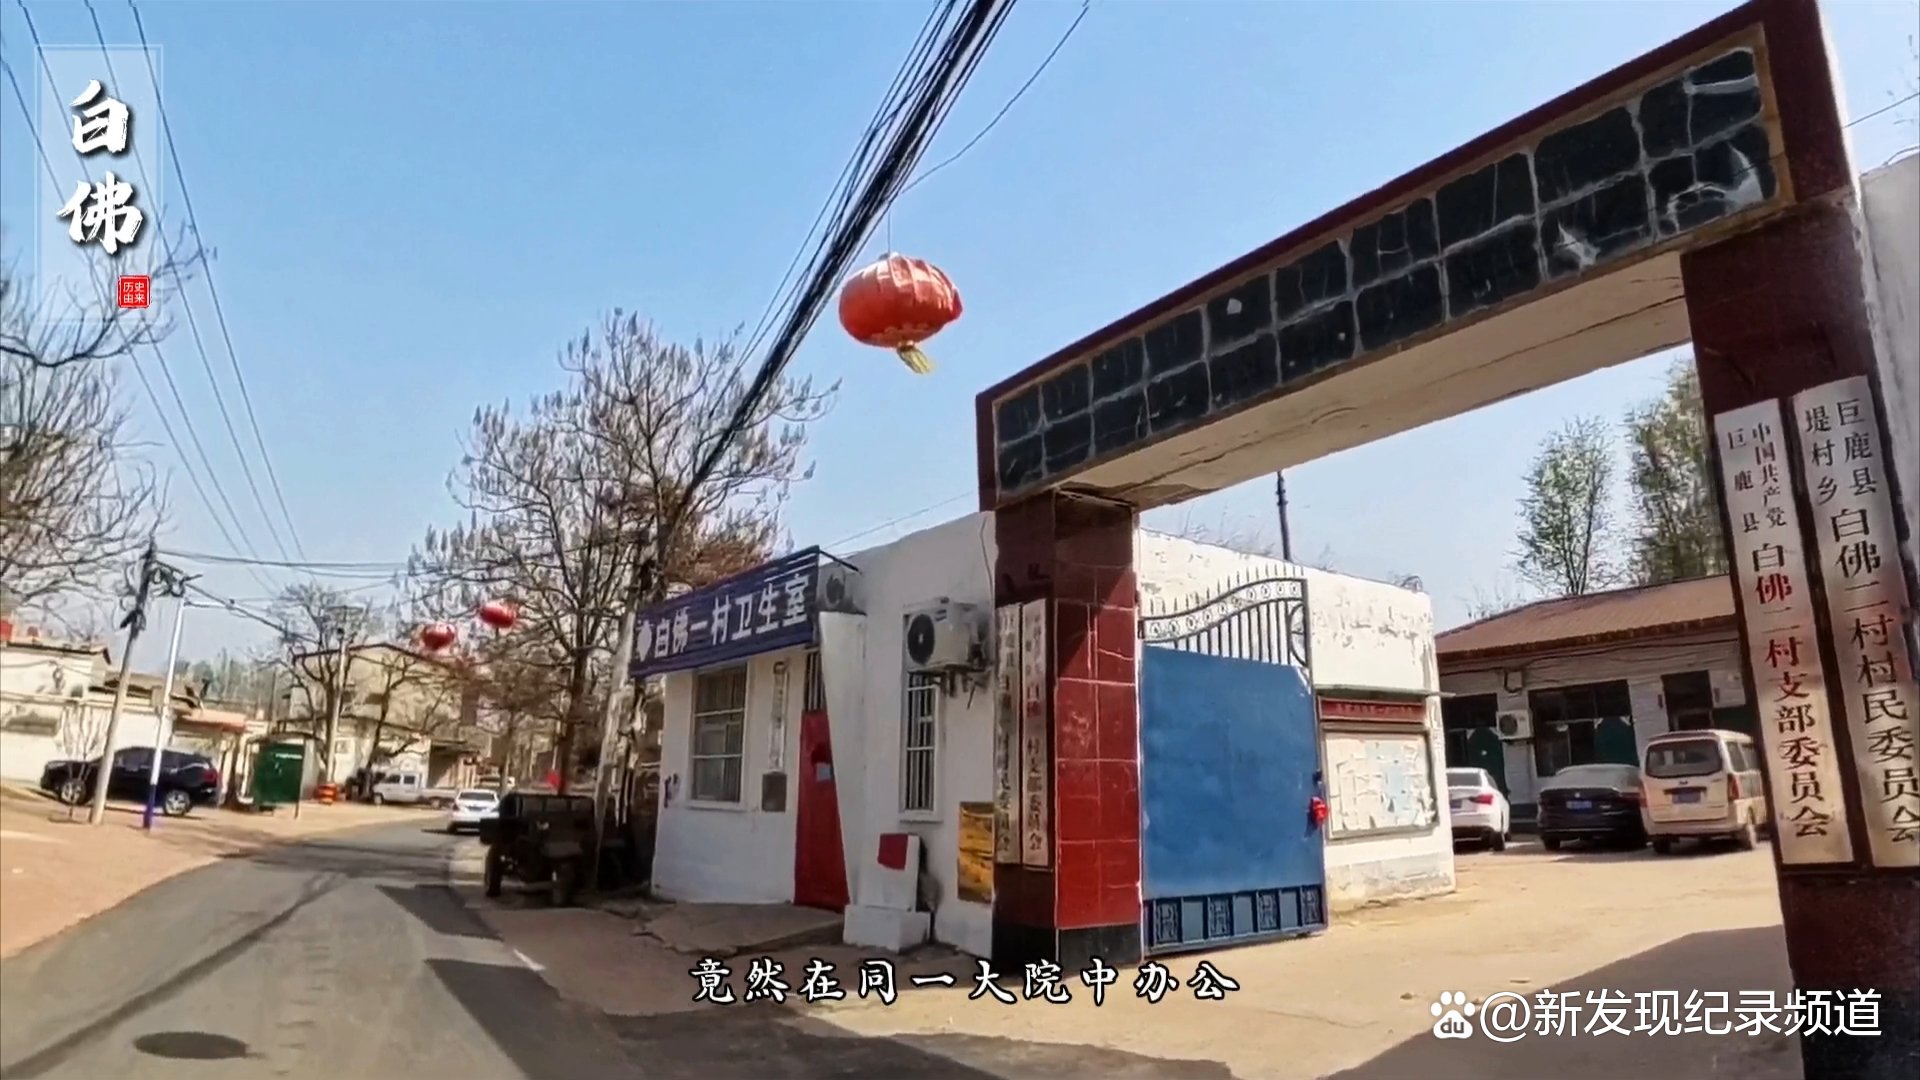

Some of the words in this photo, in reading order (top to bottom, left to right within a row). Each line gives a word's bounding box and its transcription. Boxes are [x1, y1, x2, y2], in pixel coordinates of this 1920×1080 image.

[1727, 428, 1760, 533] 巨鹿县
[1752, 421, 1787, 529] 中国共产党
[1804, 405, 1838, 506] 堤村乡
[1837, 398, 1877, 496] 巨鹿县
[654, 573, 809, 660] 白佛一村卫生室
[1752, 543, 1830, 838] 白佛二村支部委员会
